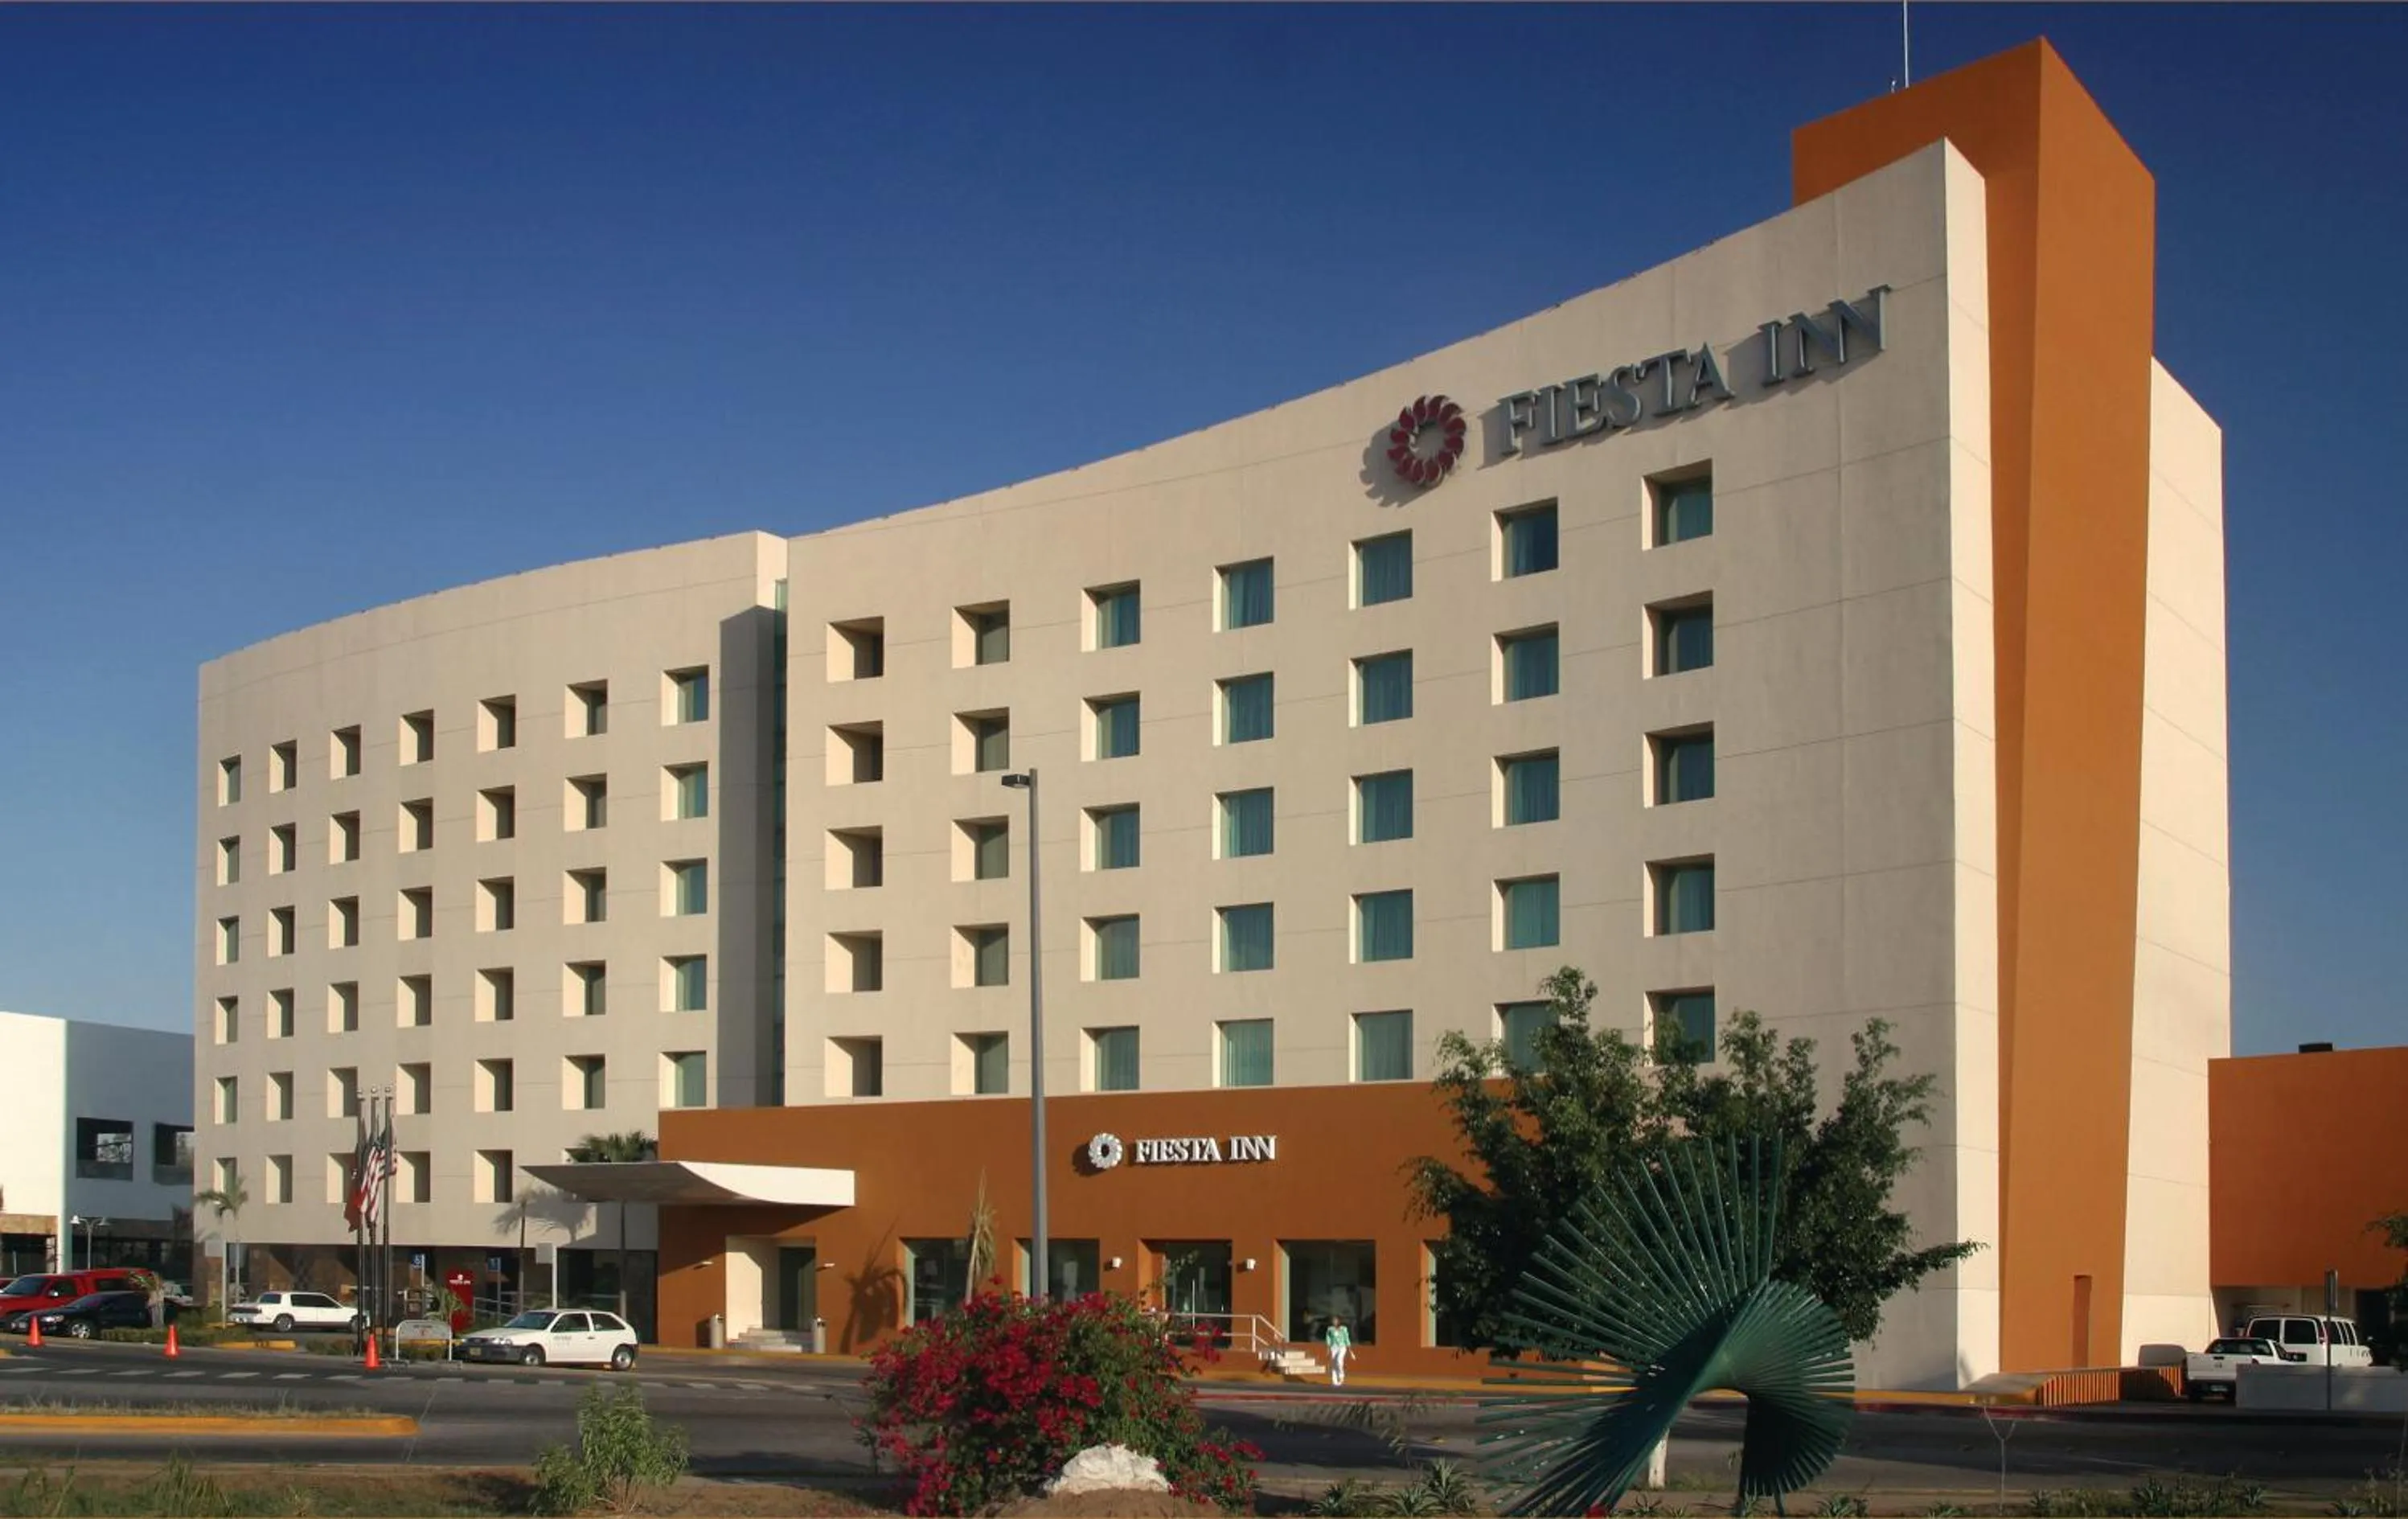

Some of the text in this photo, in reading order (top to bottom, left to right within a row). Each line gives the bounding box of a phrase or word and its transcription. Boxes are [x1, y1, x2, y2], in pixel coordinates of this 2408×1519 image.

[1497, 284, 1891, 456] FIESTA INN
[1135, 1135, 1278, 1163] FIESTA INN
